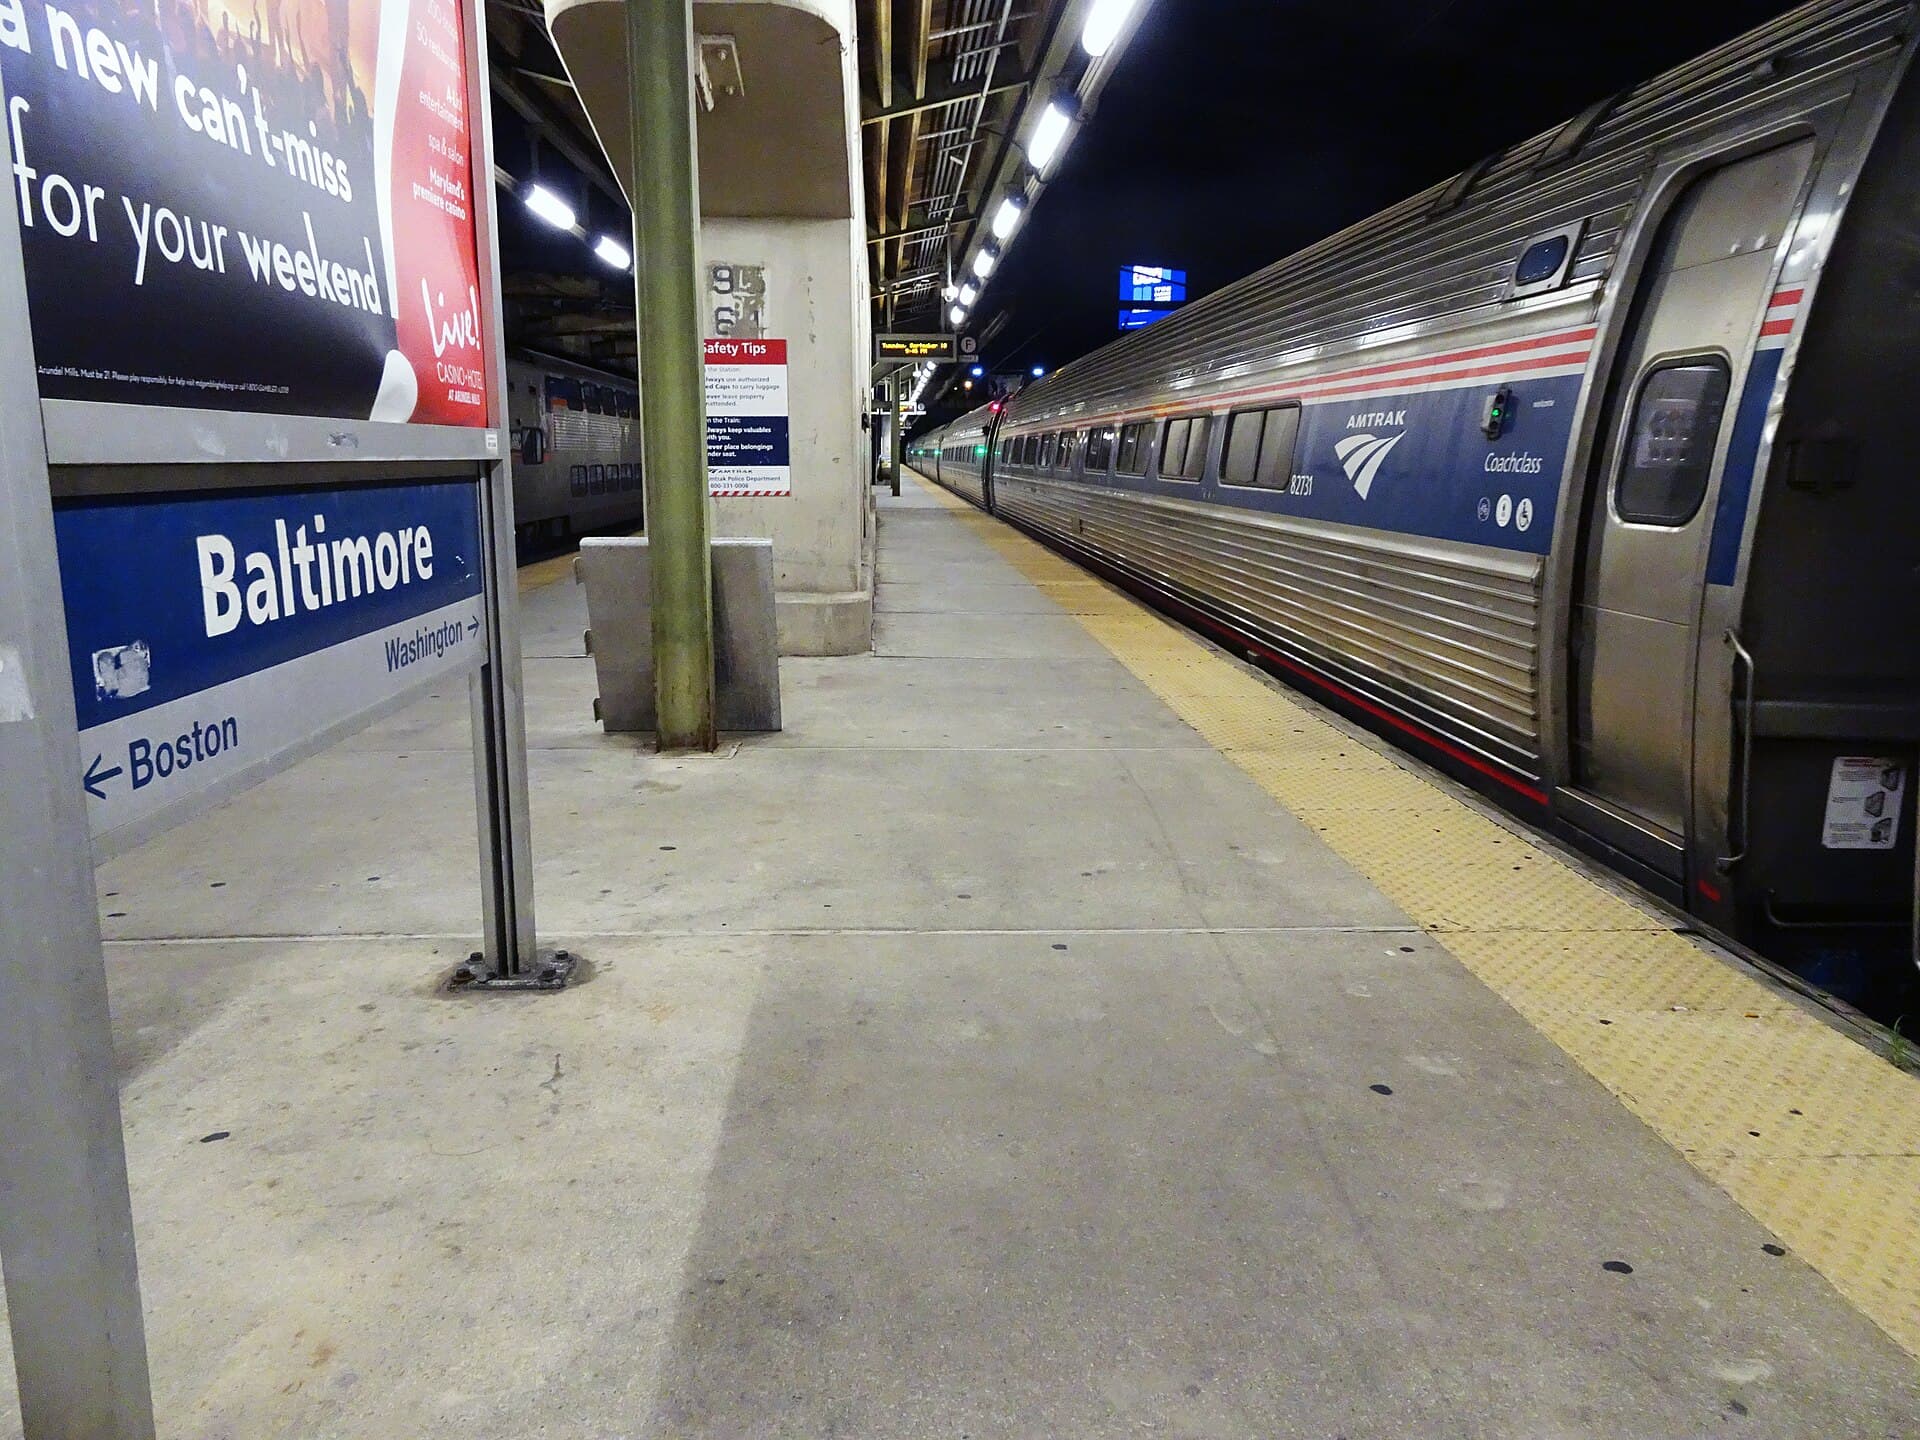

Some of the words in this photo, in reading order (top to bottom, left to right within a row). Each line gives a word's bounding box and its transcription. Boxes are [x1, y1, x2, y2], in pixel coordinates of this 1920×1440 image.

[45, 3, 158, 112] new
[174, 63, 352, 202] can't-miss
[428, 134, 442, 153] spa
[447, 144, 464, 167] salon
[429, 166, 465, 201] Maryland's
[9, 96, 105, 243] for
[122, 194, 227, 285] your
[238, 211, 383, 316] weekend
[445, 200, 466, 221] casino
[421, 277, 481, 358] Live!
[741, 341, 767, 356] Tips
[727, 426, 743, 434] keep
[743, 426, 772, 434] valuables
[1346, 409, 1407, 429] AMTRAK
[723, 443, 740, 451] place
[740, 443, 774, 451] belongings
[1484, 451, 1543, 475] Coachclass
[1290, 474, 1313, 496] 82731
[195, 514, 434, 639] Baltimore
[384, 618, 464, 674] Washington
[128, 716, 239, 791] Boston
